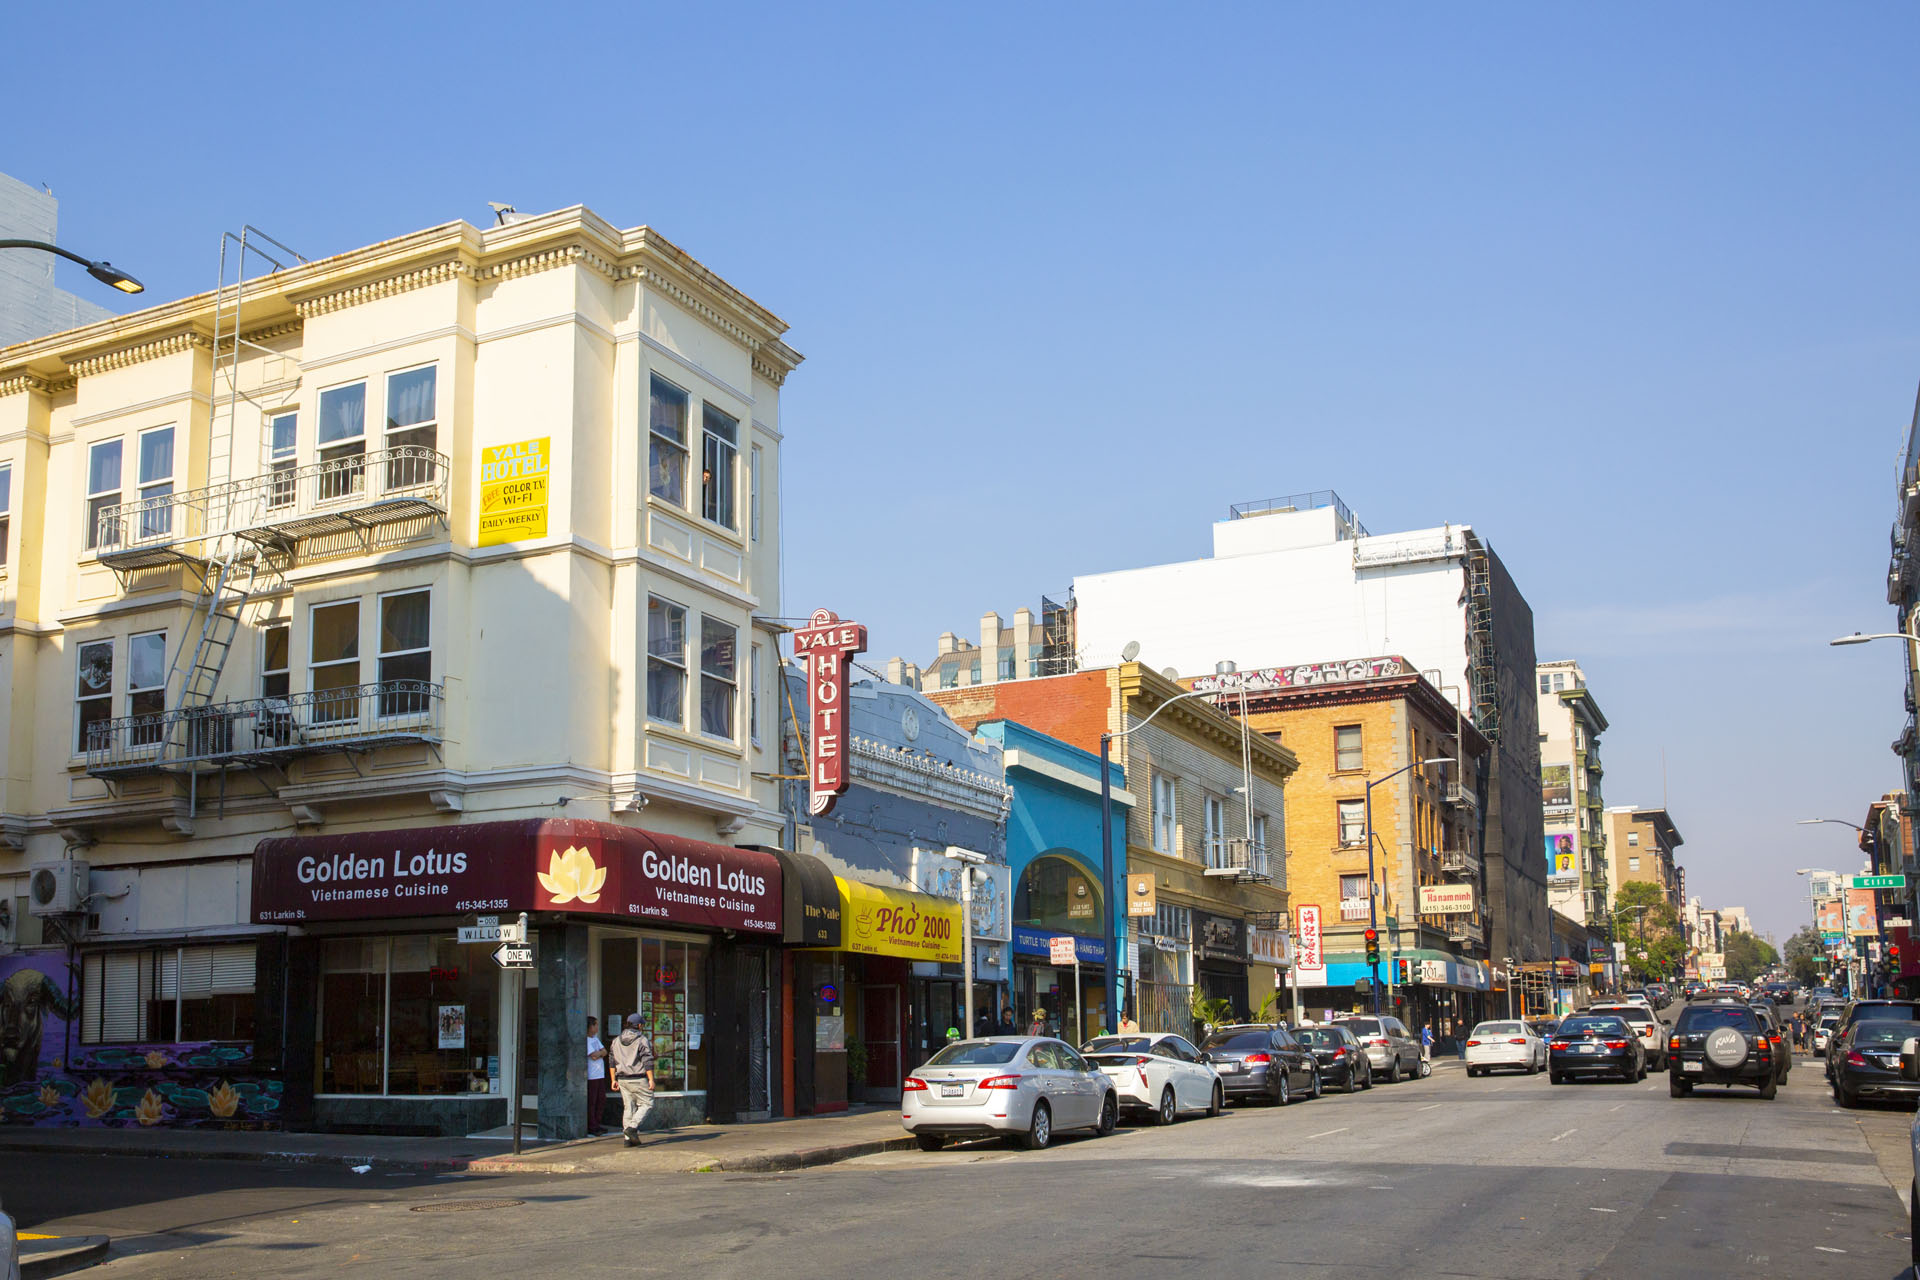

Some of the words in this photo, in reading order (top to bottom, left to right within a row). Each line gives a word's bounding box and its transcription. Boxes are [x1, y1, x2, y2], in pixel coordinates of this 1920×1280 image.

[492, 441, 540, 460] YALE
[482, 454, 548, 482] HOTEL
[503, 482, 531, 495] COLOR
[482, 487, 500, 507] FREE
[503, 493, 532, 505] WI-FI
[797, 629, 855, 649] YALE
[818, 654, 838, 784] HOTEL
[297, 853, 384, 883] Golden
[394, 848, 468, 877] Lotus
[642, 850, 711, 888] Golden
[717, 863, 765, 896] Lotus
[1863, 878, 1894, 886] Ellis
[311, 886, 389, 902] Vietnamese
[394, 882, 449, 897] Cuisine
[655, 886, 716, 907] Vietnamese
[719, 896, 755, 913] Cuisine
[455, 899, 509, 911] 415-345-1355
[628, 904, 640, 913] 631
[641, 904, 660, 916] Larkin
[805, 904, 821, 917] The
[821, 906, 840, 921] Yale
[259, 911, 273, 920] 631
[273, 910, 296, 919] Larkin
[743, 919, 777, 930] 415-345-1355
[923, 915, 951, 940] 2000
[464, 929, 512, 939] WILLOW
[1018, 935, 1039, 947] TURTLE
[888, 935, 920, 948] Vietnamese
[921, 939, 941, 950] Cuisine
[507, 951, 523, 960] ONE
